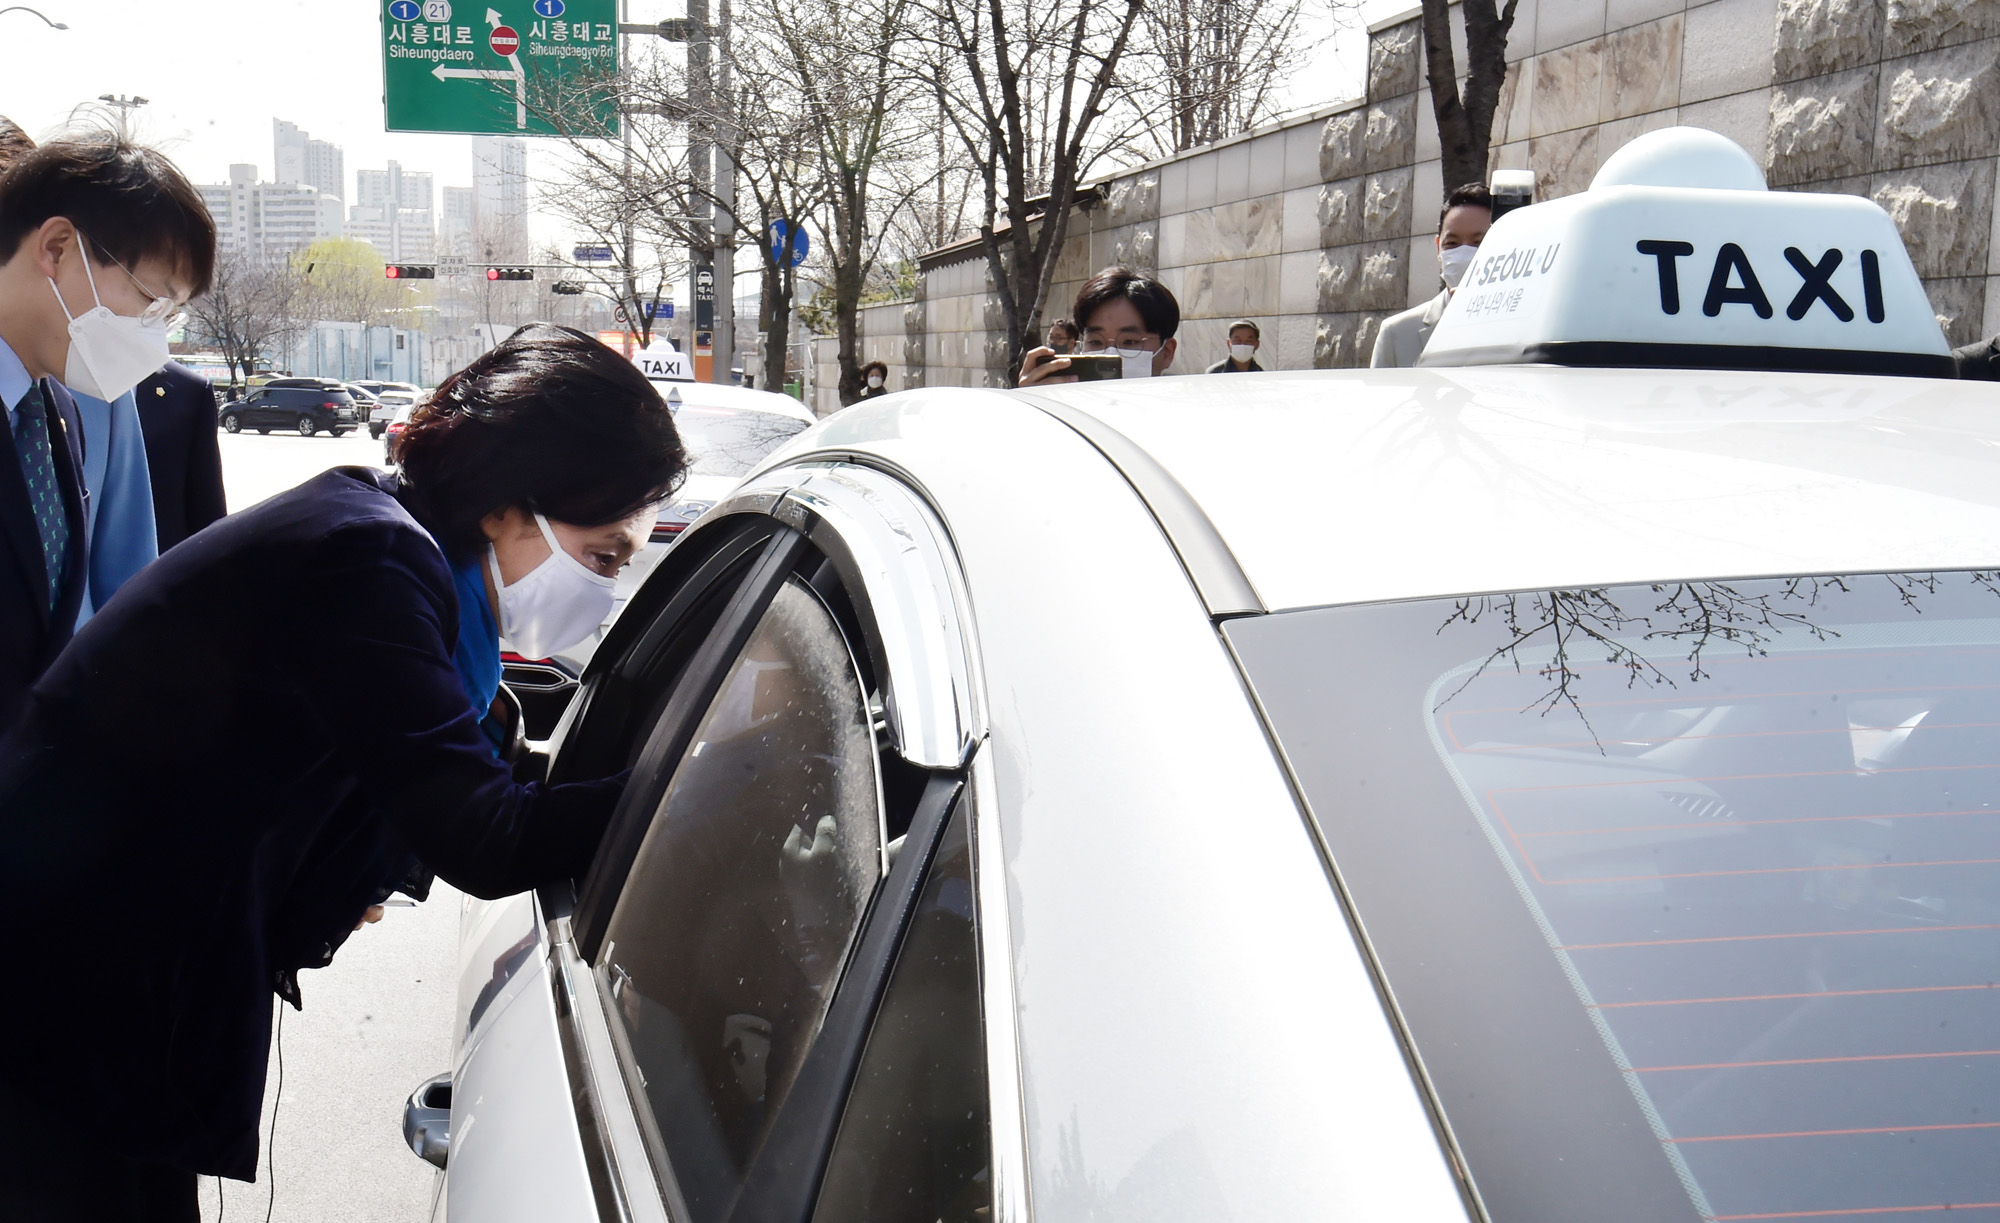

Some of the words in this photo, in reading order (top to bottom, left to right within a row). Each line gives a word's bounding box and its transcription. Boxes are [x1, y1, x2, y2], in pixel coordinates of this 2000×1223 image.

[400, 3, 408, 18] 1
[429, 3, 446, 18] 21
[544, 0, 552, 15] 1
[388, 22, 474, 45] 시흥대로
[528, 20, 612, 42] 시흥대교
[389, 44, 474, 62] Siheungdaero
[1636, 239, 1885, 324] TAXI
[642, 359, 681, 376] TAXI
